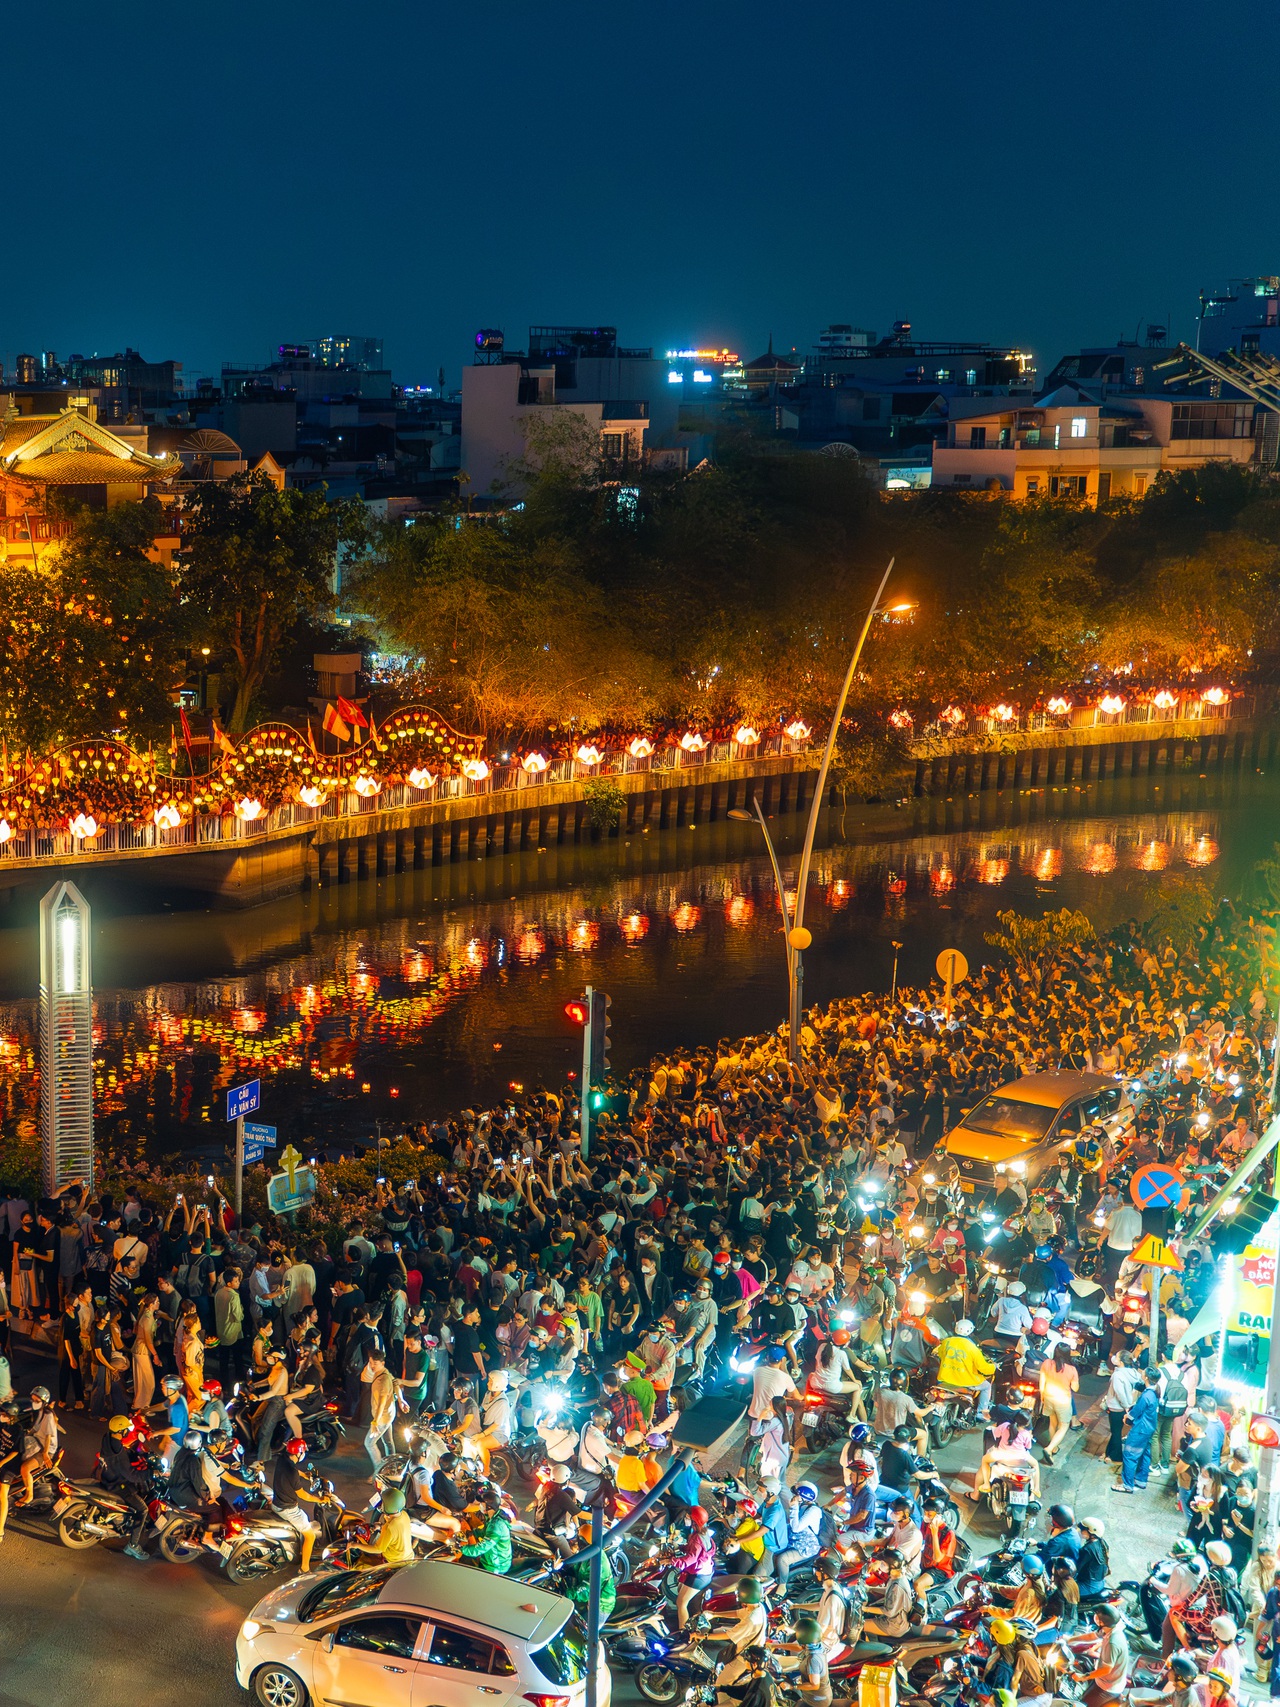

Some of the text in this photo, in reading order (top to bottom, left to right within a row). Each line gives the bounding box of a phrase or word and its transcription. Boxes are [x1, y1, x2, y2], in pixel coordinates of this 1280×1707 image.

[230, 1104, 237, 1117] LÊ
[239, 1100, 249, 1113] VĂN
[1248, 1269, 1271, 1281] ĐẶC
